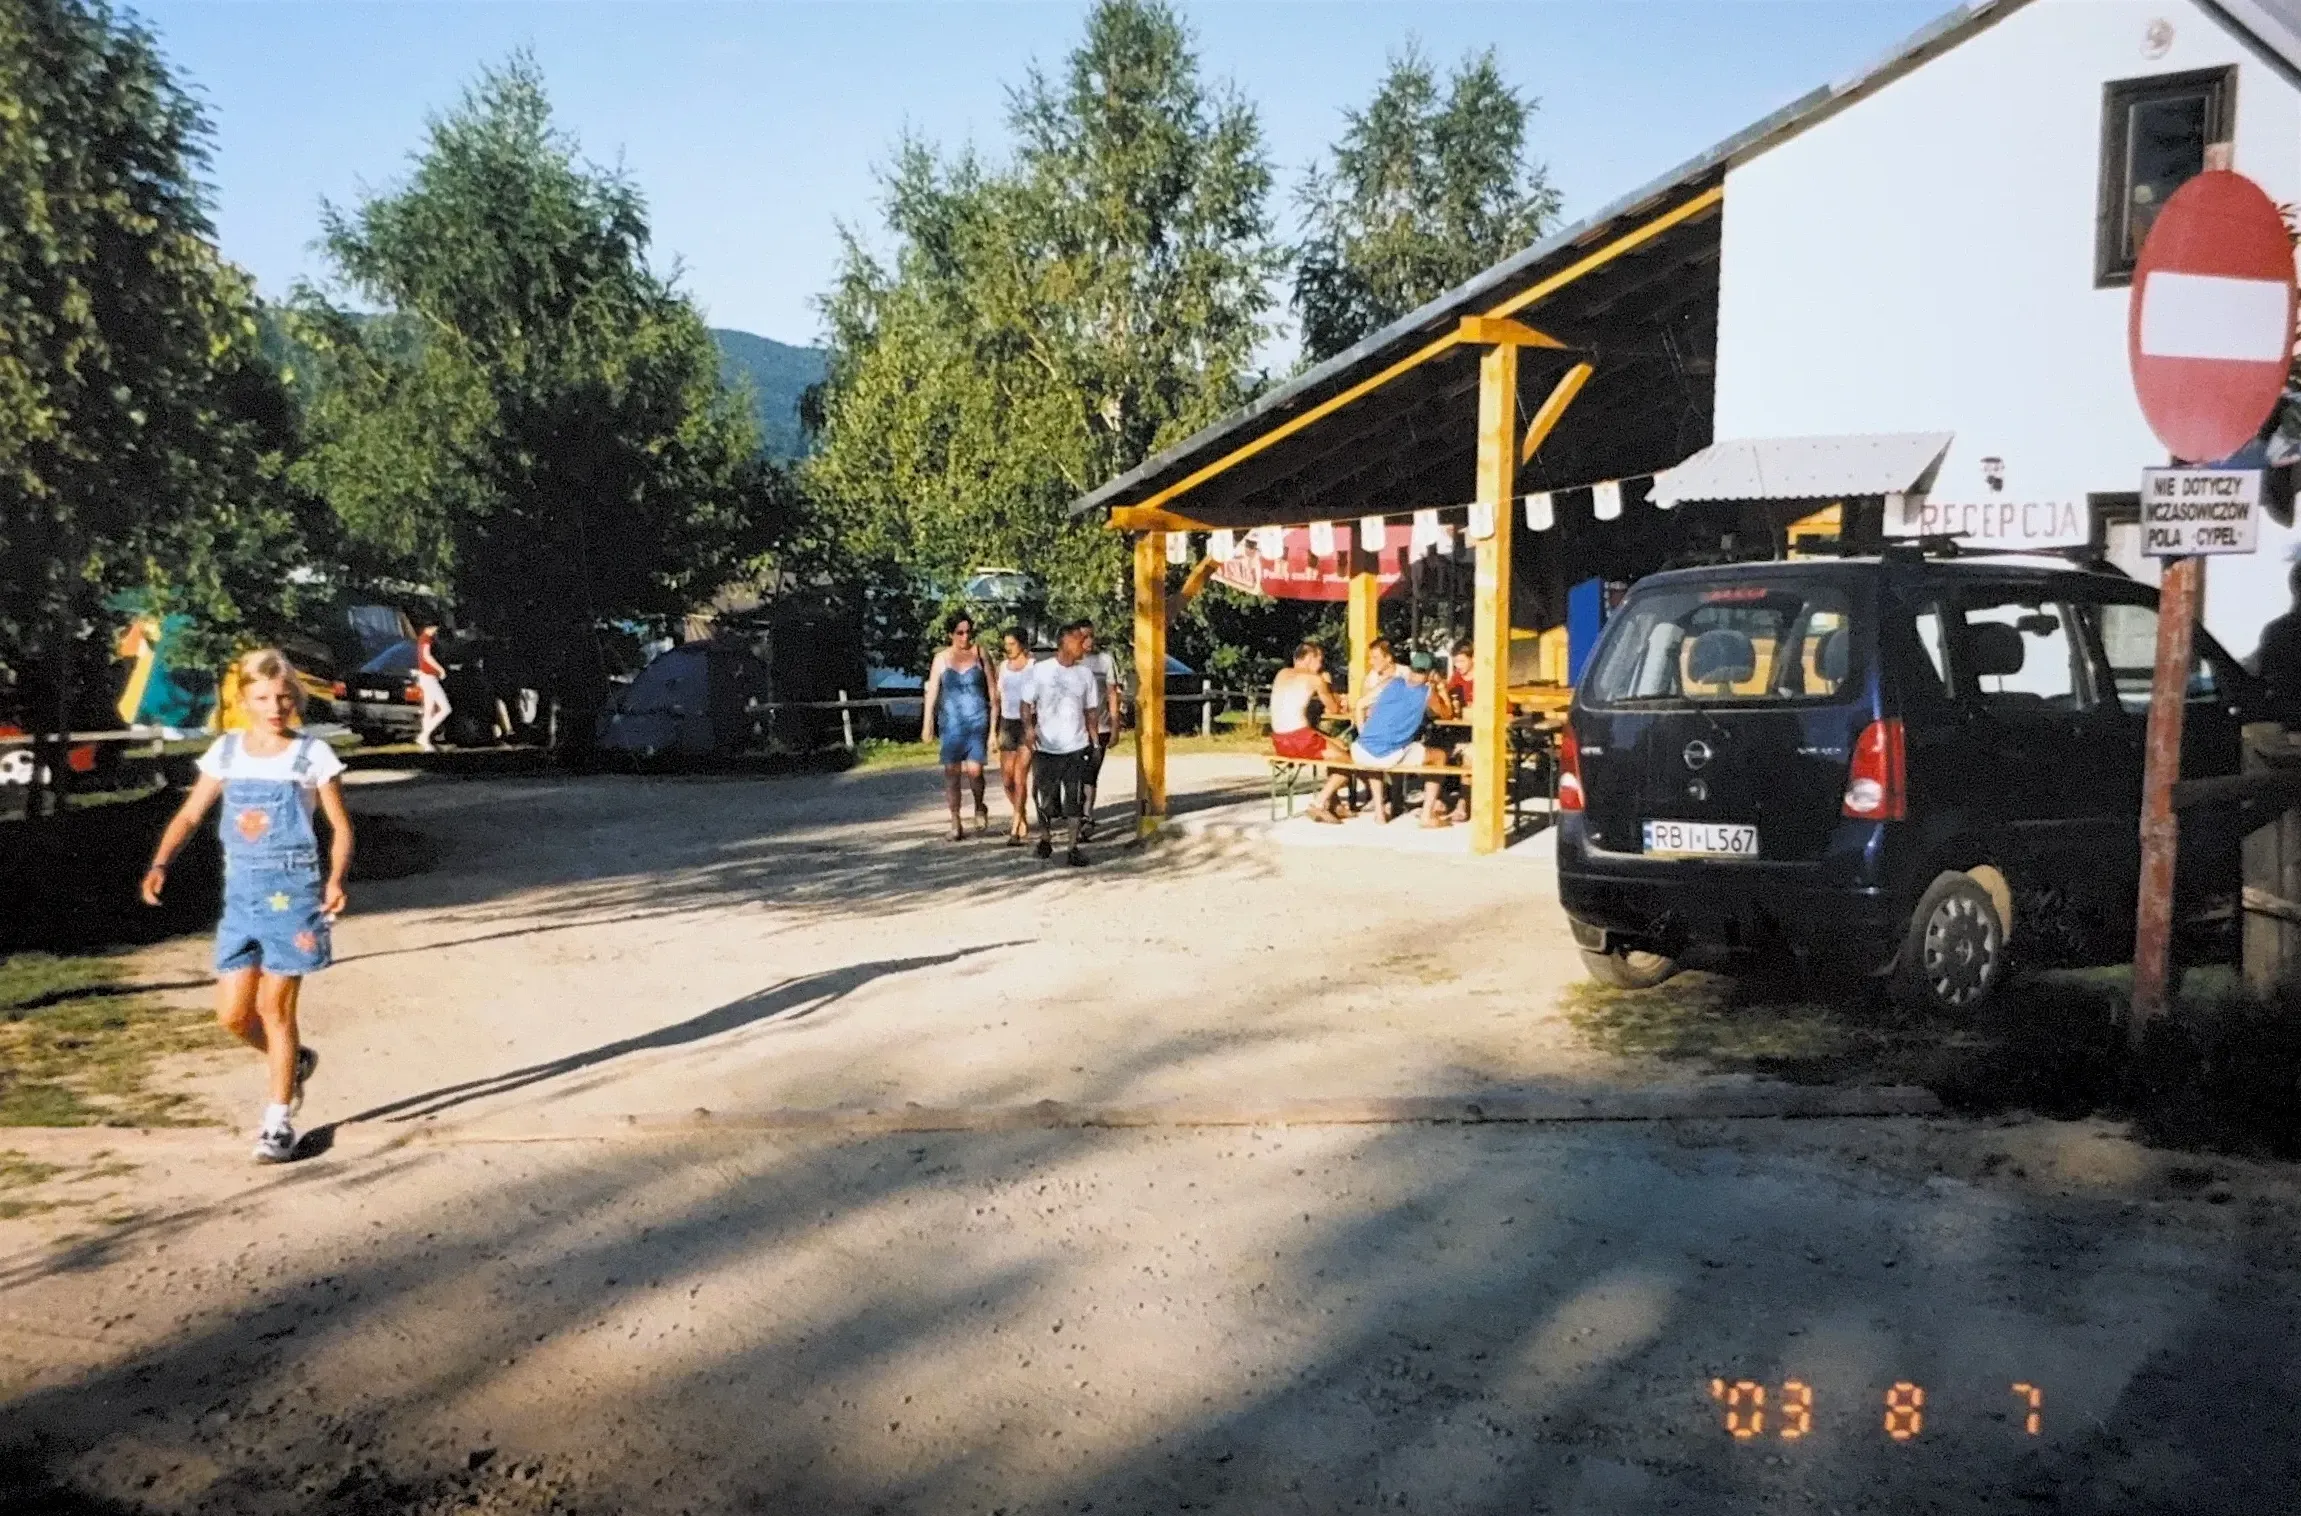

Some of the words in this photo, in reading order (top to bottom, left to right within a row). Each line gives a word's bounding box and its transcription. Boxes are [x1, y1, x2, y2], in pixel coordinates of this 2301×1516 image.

[2153, 477, 2176, 497] NIE
[2182, 476, 2242, 497] DOTYCZY
[1919, 502, 2080, 538] RECEPCJA
[2147, 527, 2182, 548] POLA
[1705, 827, 1754, 853] L567
